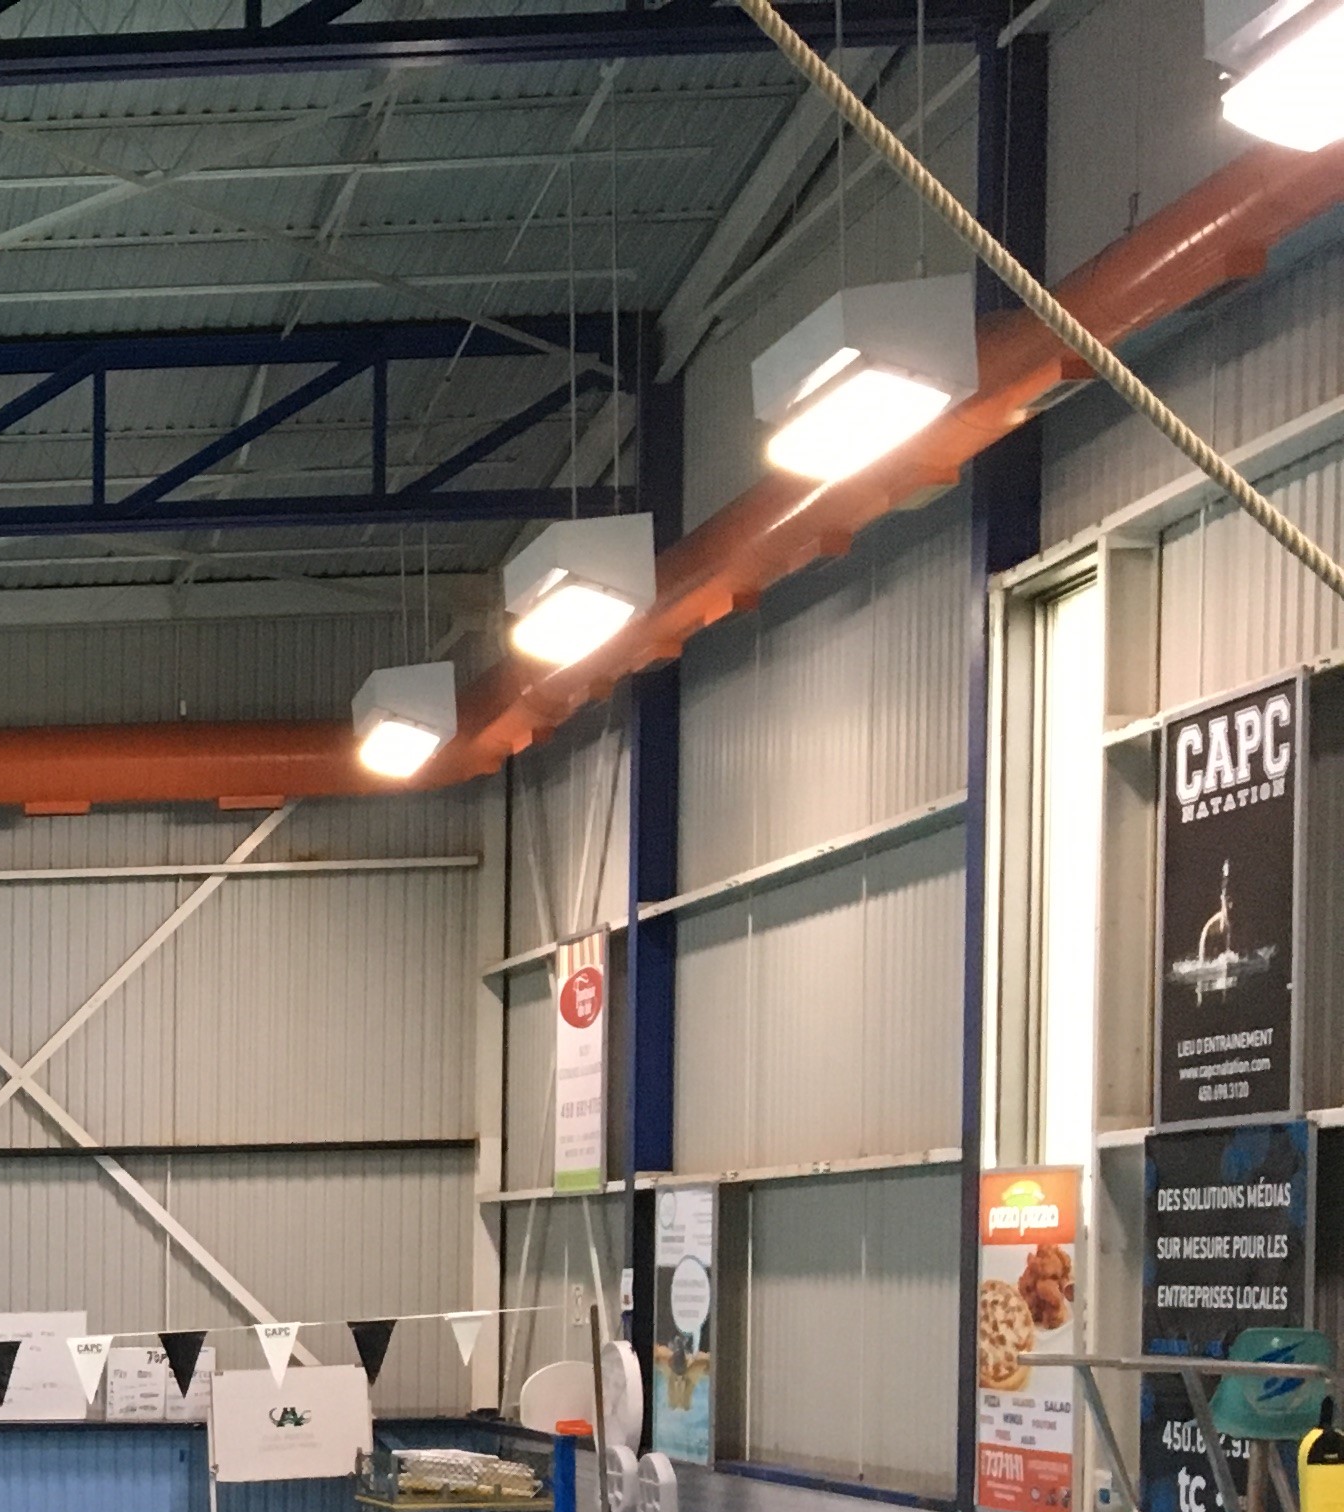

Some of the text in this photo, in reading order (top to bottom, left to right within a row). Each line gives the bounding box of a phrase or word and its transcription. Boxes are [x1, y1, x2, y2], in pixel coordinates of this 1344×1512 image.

[1176, 693, 1291, 805] CAPC
[1181, 777, 1286, 823] NATATION
[1158, 1176, 1291, 1211] DES SOLUTIONS MÉDIAS
[1157, 1234, 1288, 1259] SUR MESURE POUR LES
[1157, 1285, 1288, 1310] ENTREPRISES LOCALES
[265, 1327, 290, 1338] CAPC
[77, 1344, 102, 1354] CAPC
[1044, 1401, 1072, 1413] SALAD
